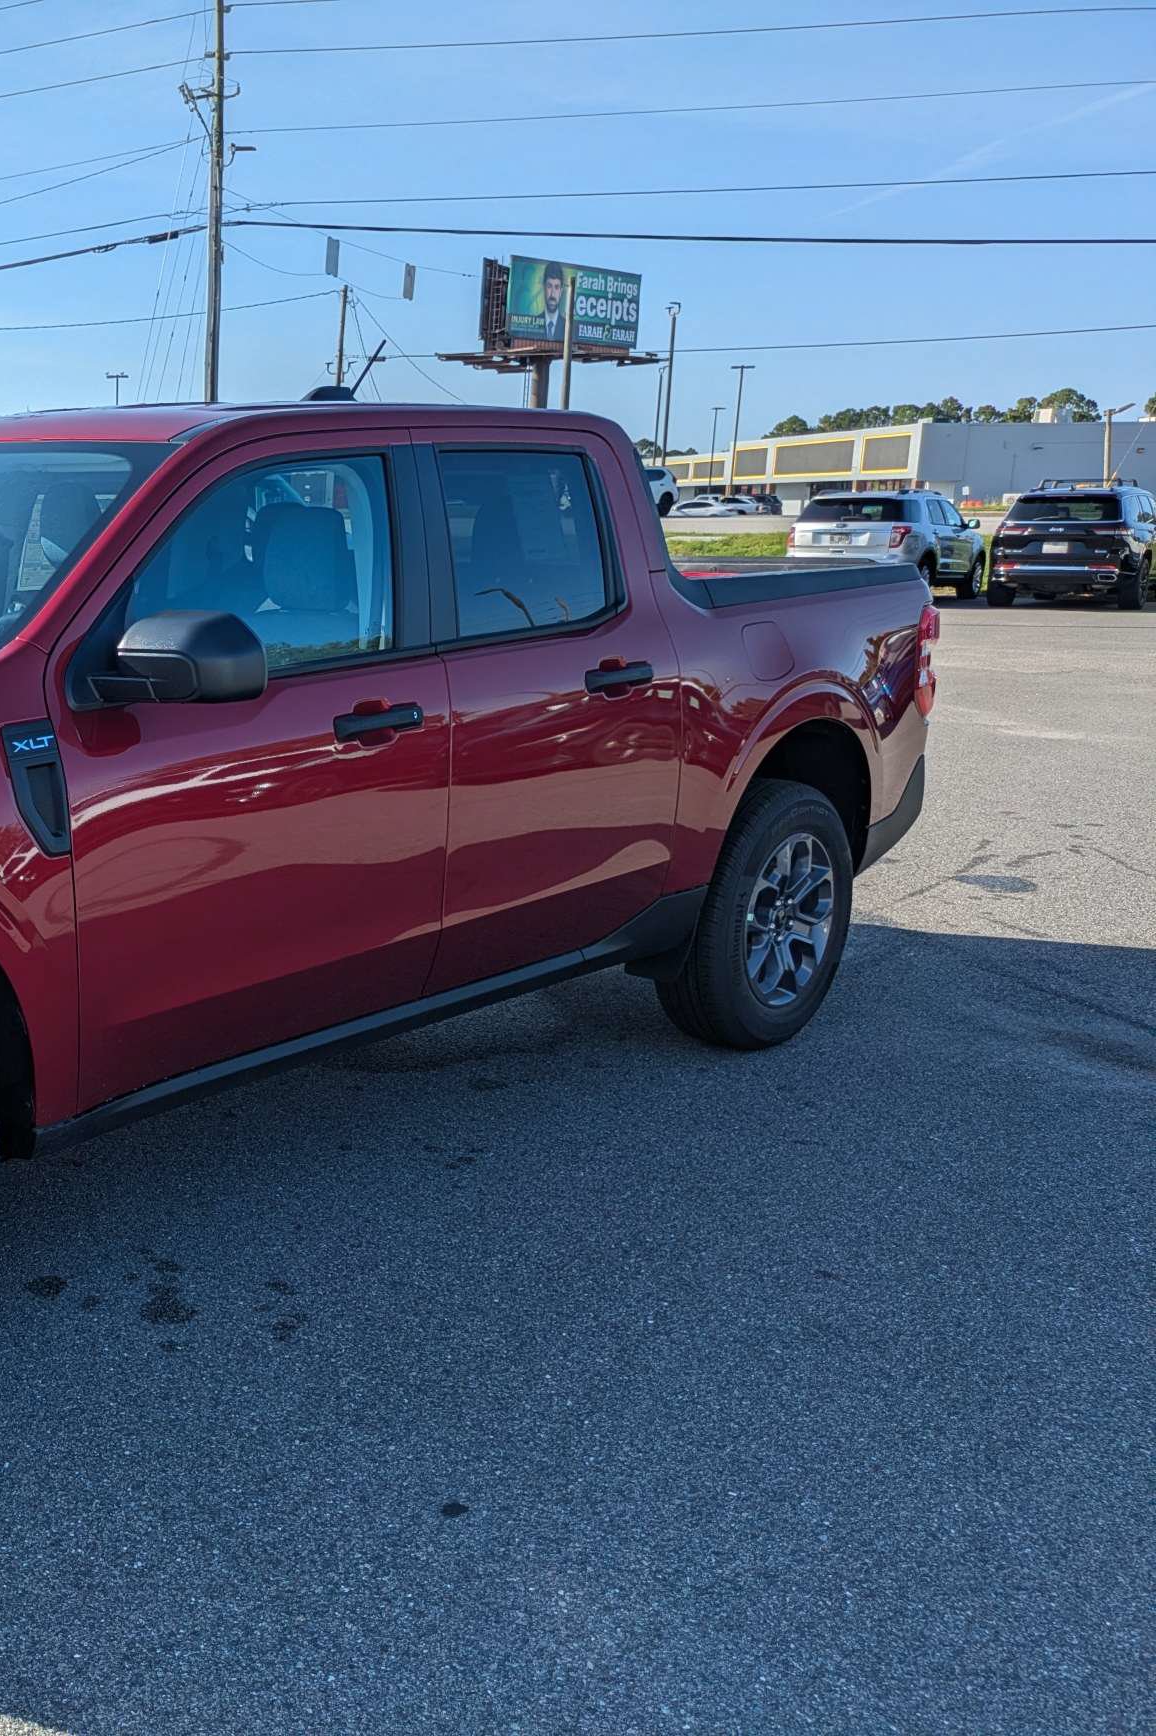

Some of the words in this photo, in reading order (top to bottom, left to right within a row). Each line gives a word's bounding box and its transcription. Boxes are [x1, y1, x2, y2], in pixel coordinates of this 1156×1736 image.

[576, 271, 605, 293] Farah
[607, 276, 638, 299] Brings
[573, 294, 637, 324] eceipts
[578, 324, 603, 338] FARAH
[611, 329, 635, 342] FARAH
[11, 735, 55, 753] XLT
